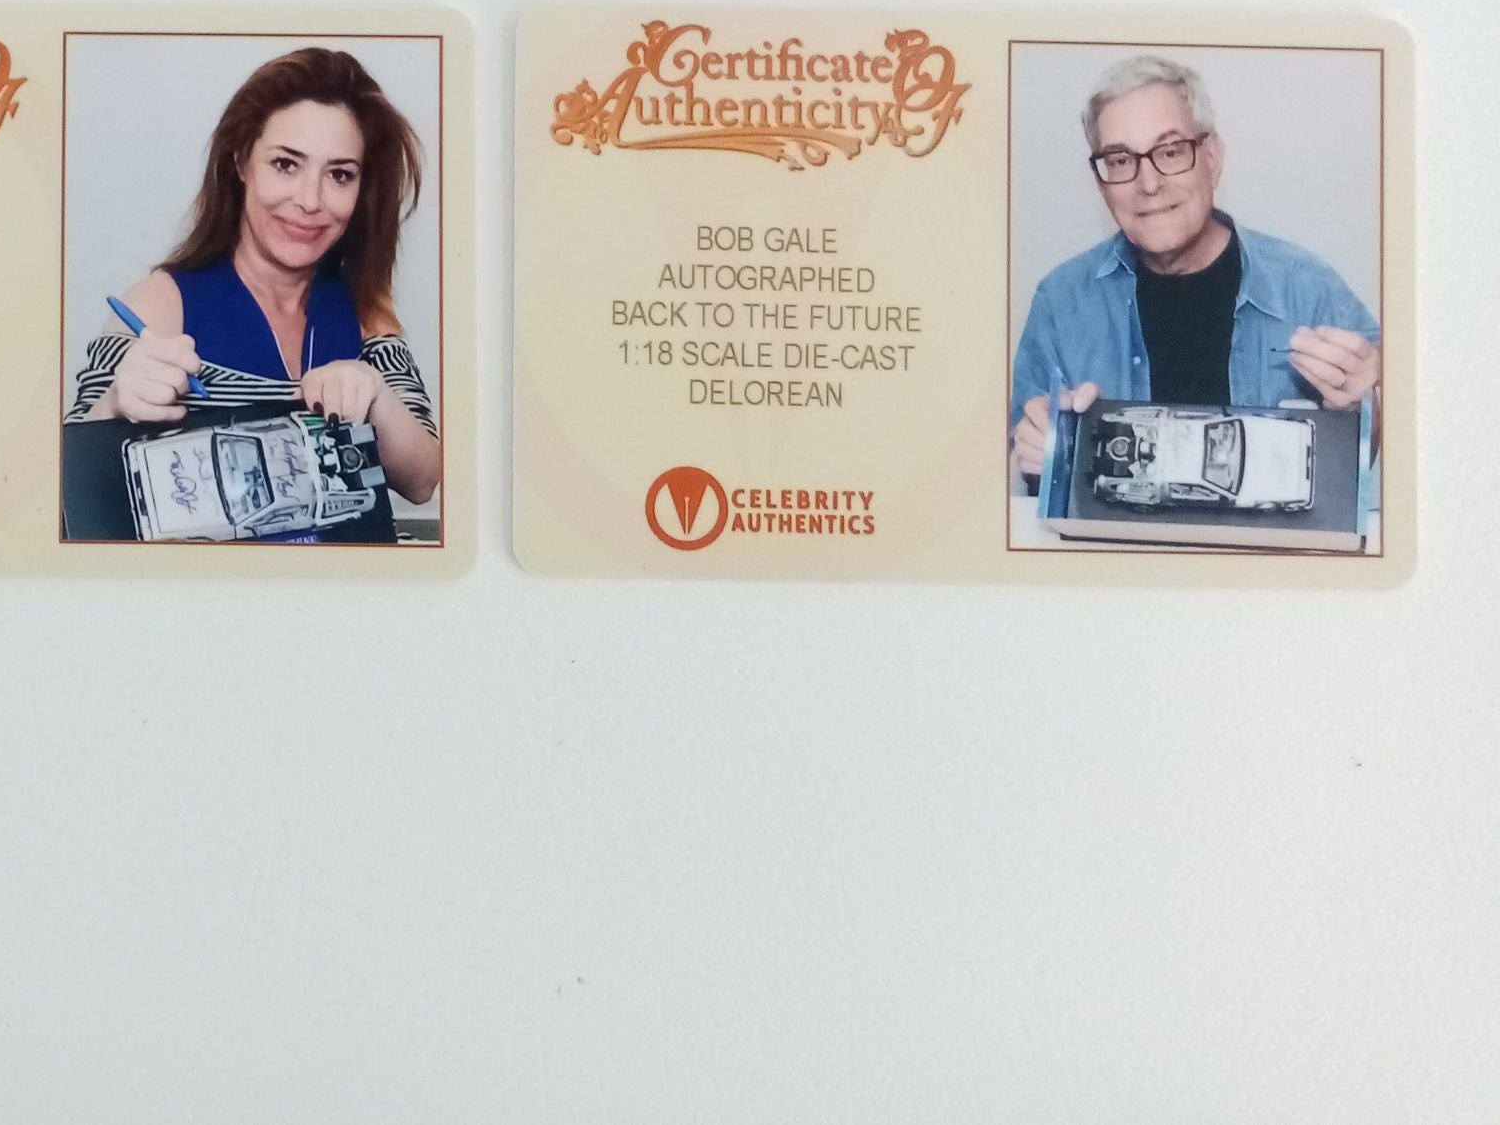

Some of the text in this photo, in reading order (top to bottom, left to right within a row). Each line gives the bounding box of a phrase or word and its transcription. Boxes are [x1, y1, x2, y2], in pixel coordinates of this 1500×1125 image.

[627, 20, 893, 87] Certificate
[595, 68, 886, 148] Authenticity
[696, 224, 838, 255] BOB GALE
[657, 262, 876, 294] AUTOGRAPHED
[611, 299, 922, 333] BACK TO THE FUTURE
[618, 339, 916, 372] 1:18 SCALE DIE-CAST
[688, 378, 843, 408] DELOREAN
[730, 487, 875, 512] CELEBRITY
[730, 511, 876, 536] AUTHENTICS
